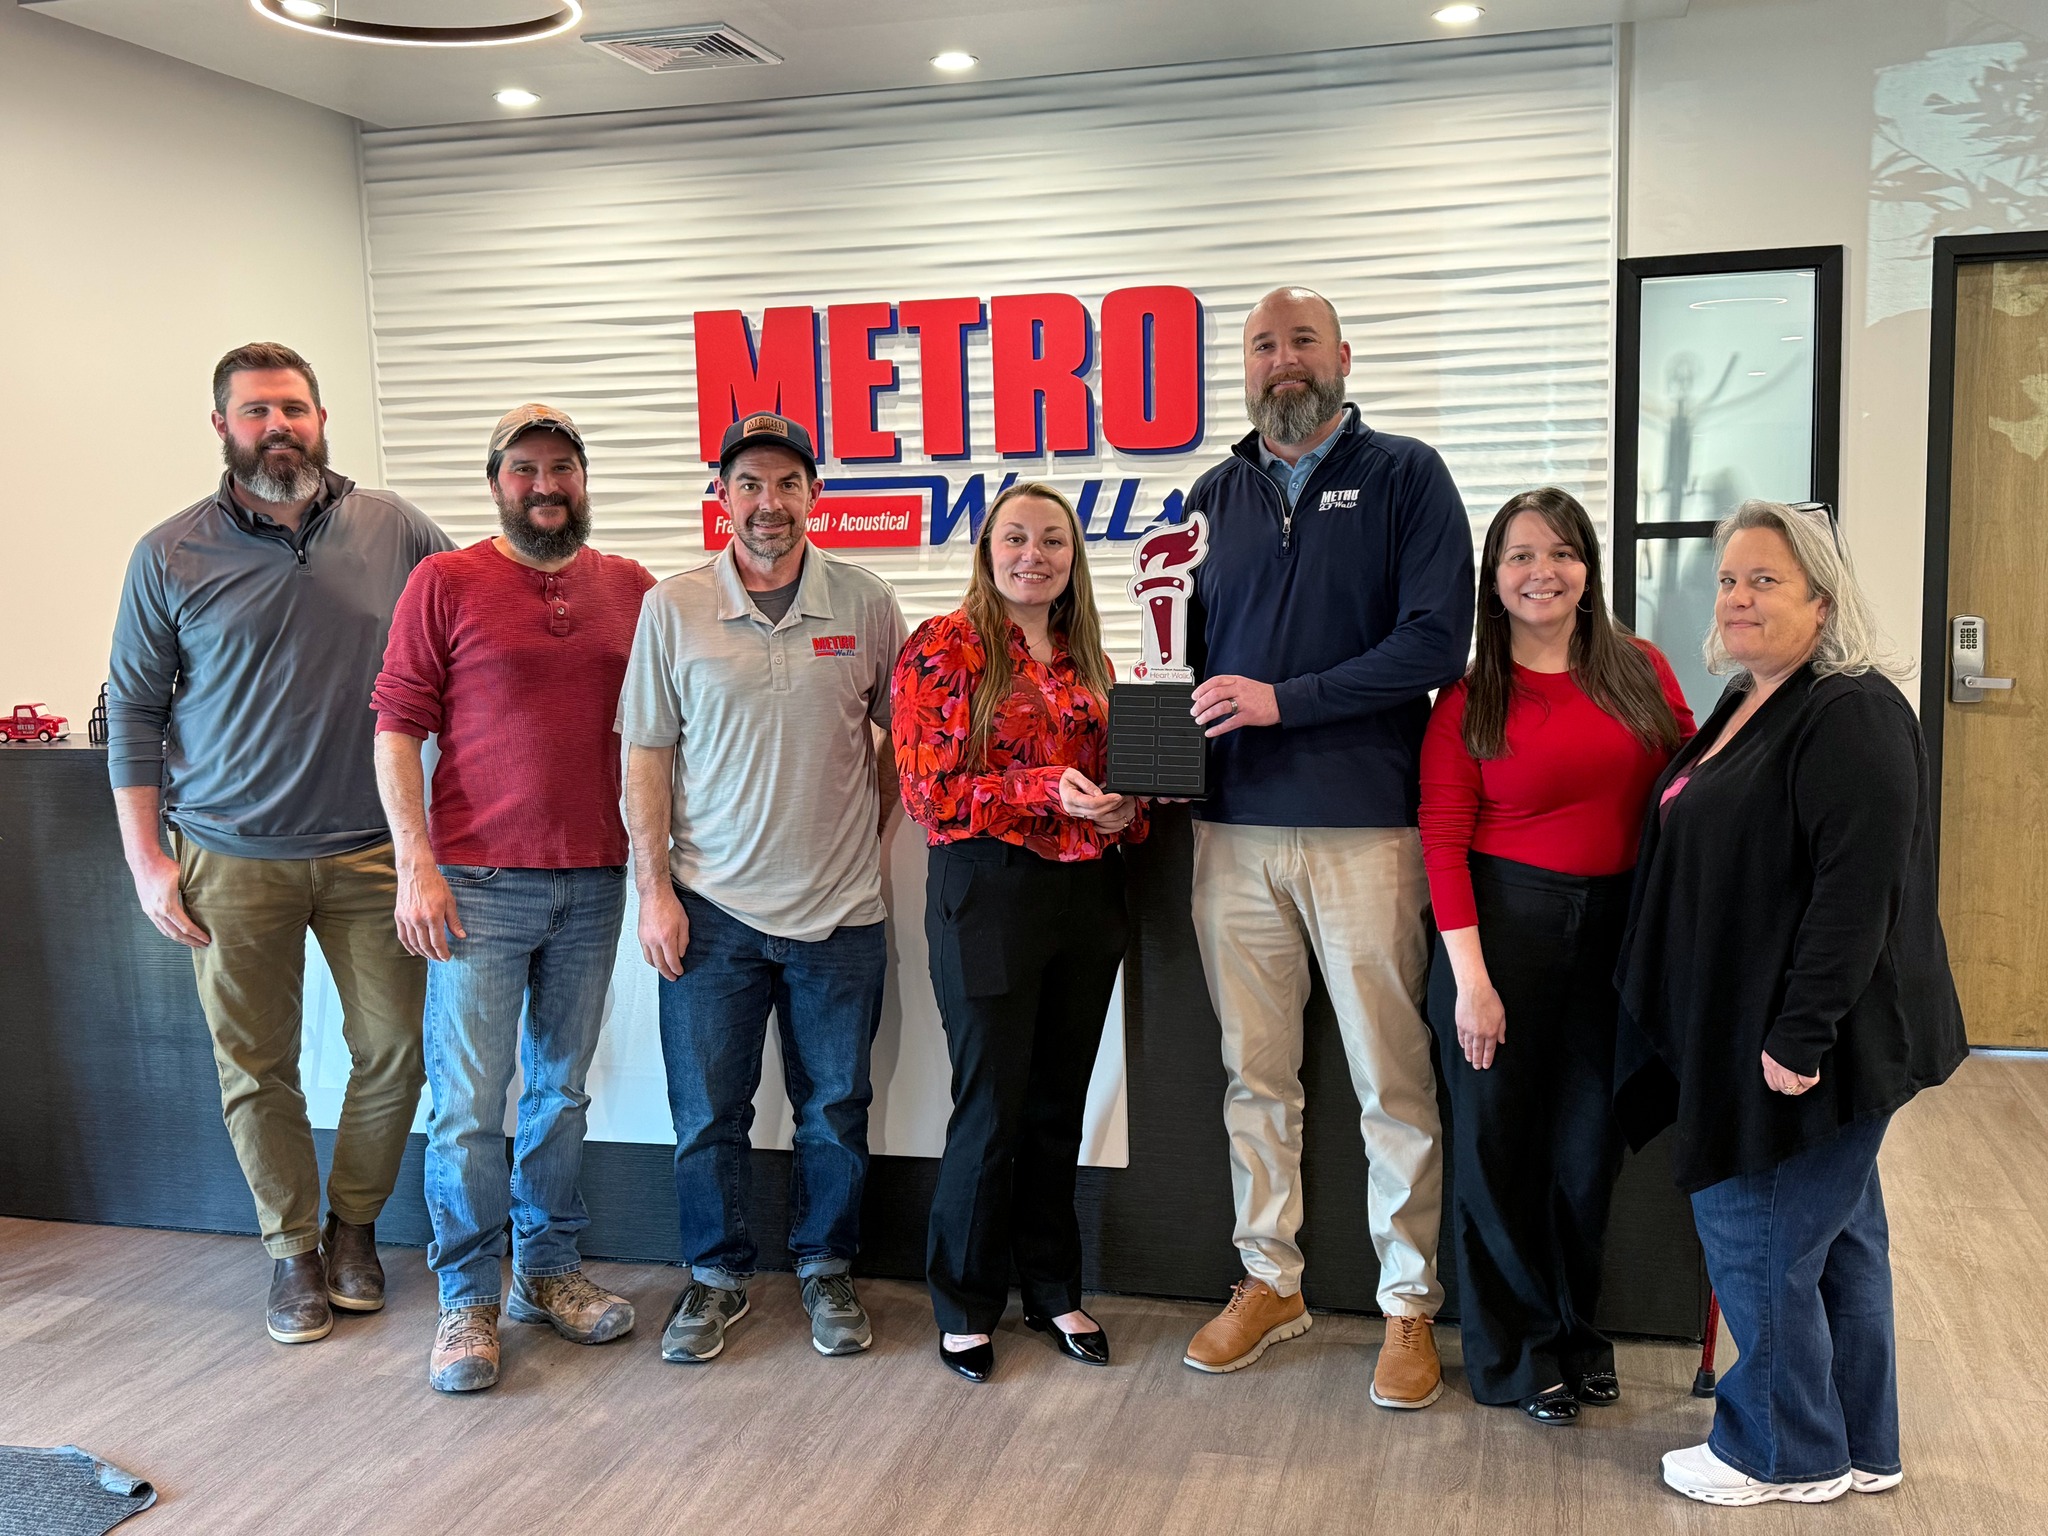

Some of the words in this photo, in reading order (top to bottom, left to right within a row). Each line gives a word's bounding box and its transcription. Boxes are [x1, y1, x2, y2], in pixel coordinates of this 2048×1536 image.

[694, 285, 1203, 466] METRO
[1321, 489, 1360, 504] METRO
[838, 511, 910, 532] Acoustical
[812, 635, 856, 650] METRO
